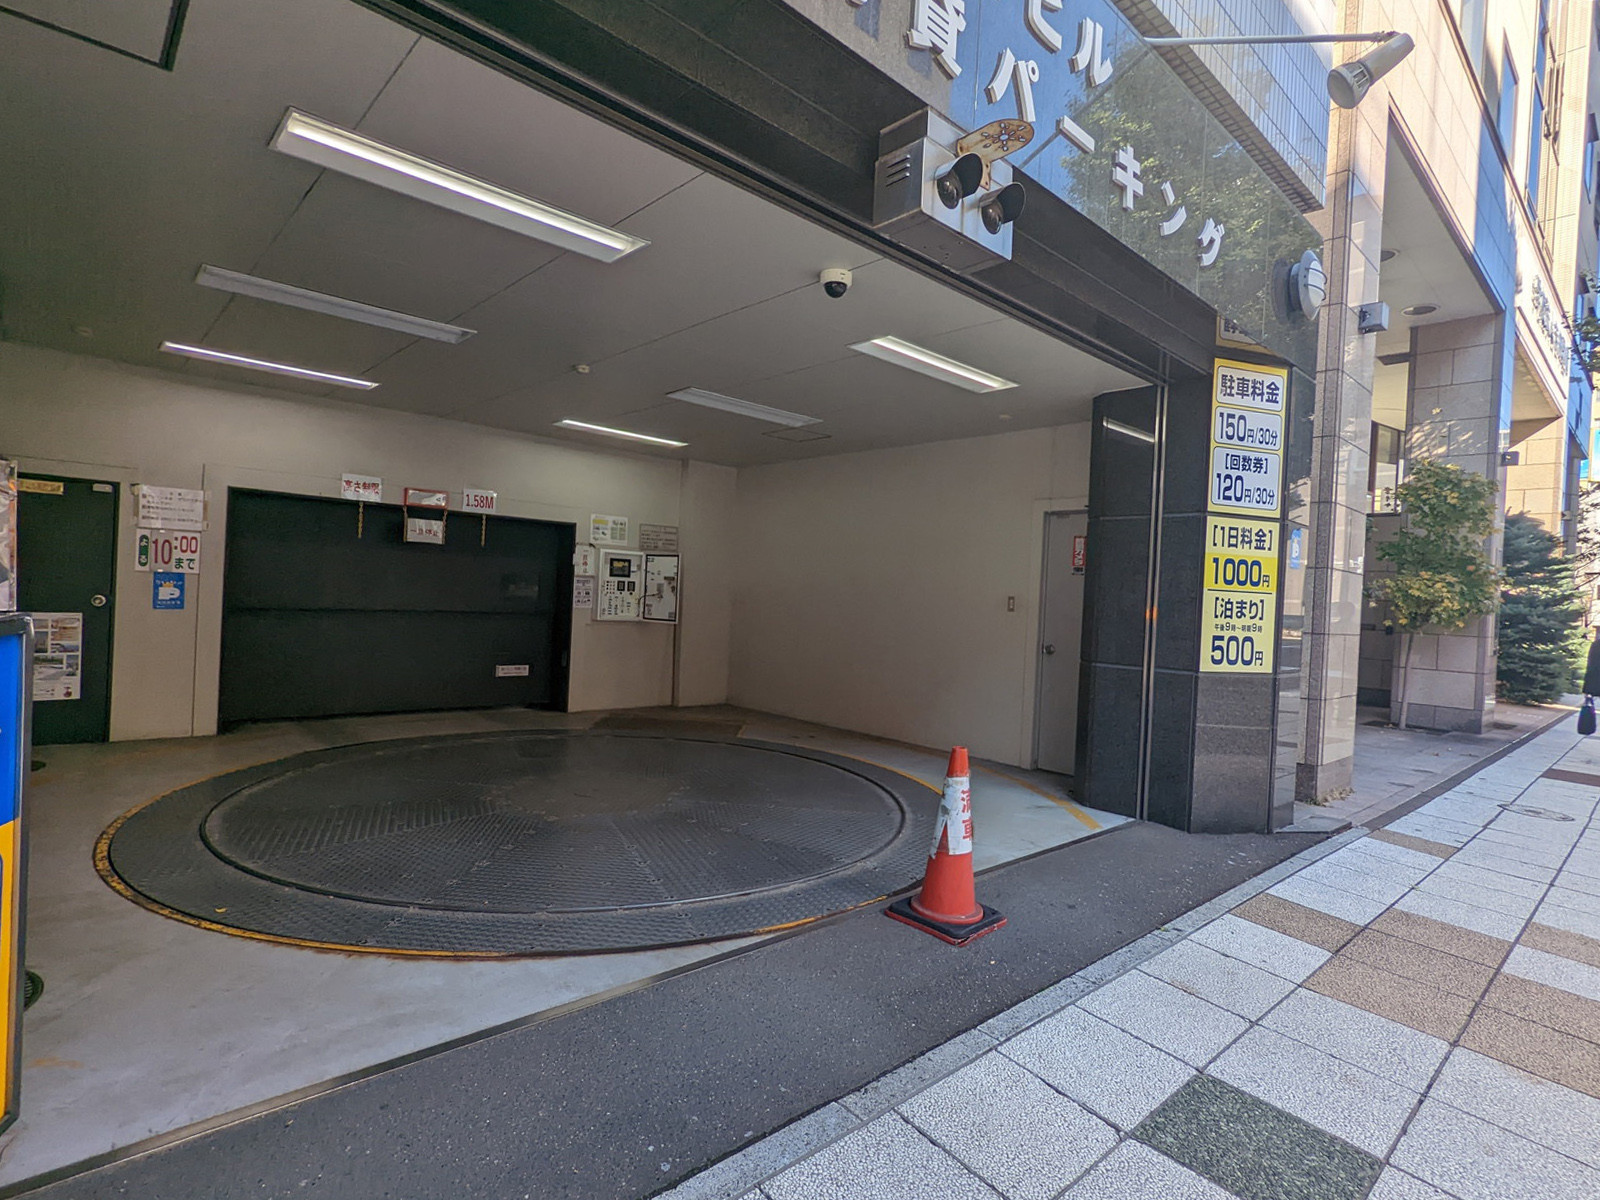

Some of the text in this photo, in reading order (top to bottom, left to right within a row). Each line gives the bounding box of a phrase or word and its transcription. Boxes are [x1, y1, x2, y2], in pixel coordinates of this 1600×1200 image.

[846, 0, 1224, 267] 貸パーキング
[1220, 374, 1280, 404] 駐車料金
[465, 494, 494, 509] 1.58M
[174, 557, 196, 570] まで
[1212, 557, 1270, 588] 1000円
[1210, 634, 1264, 667] 500円
